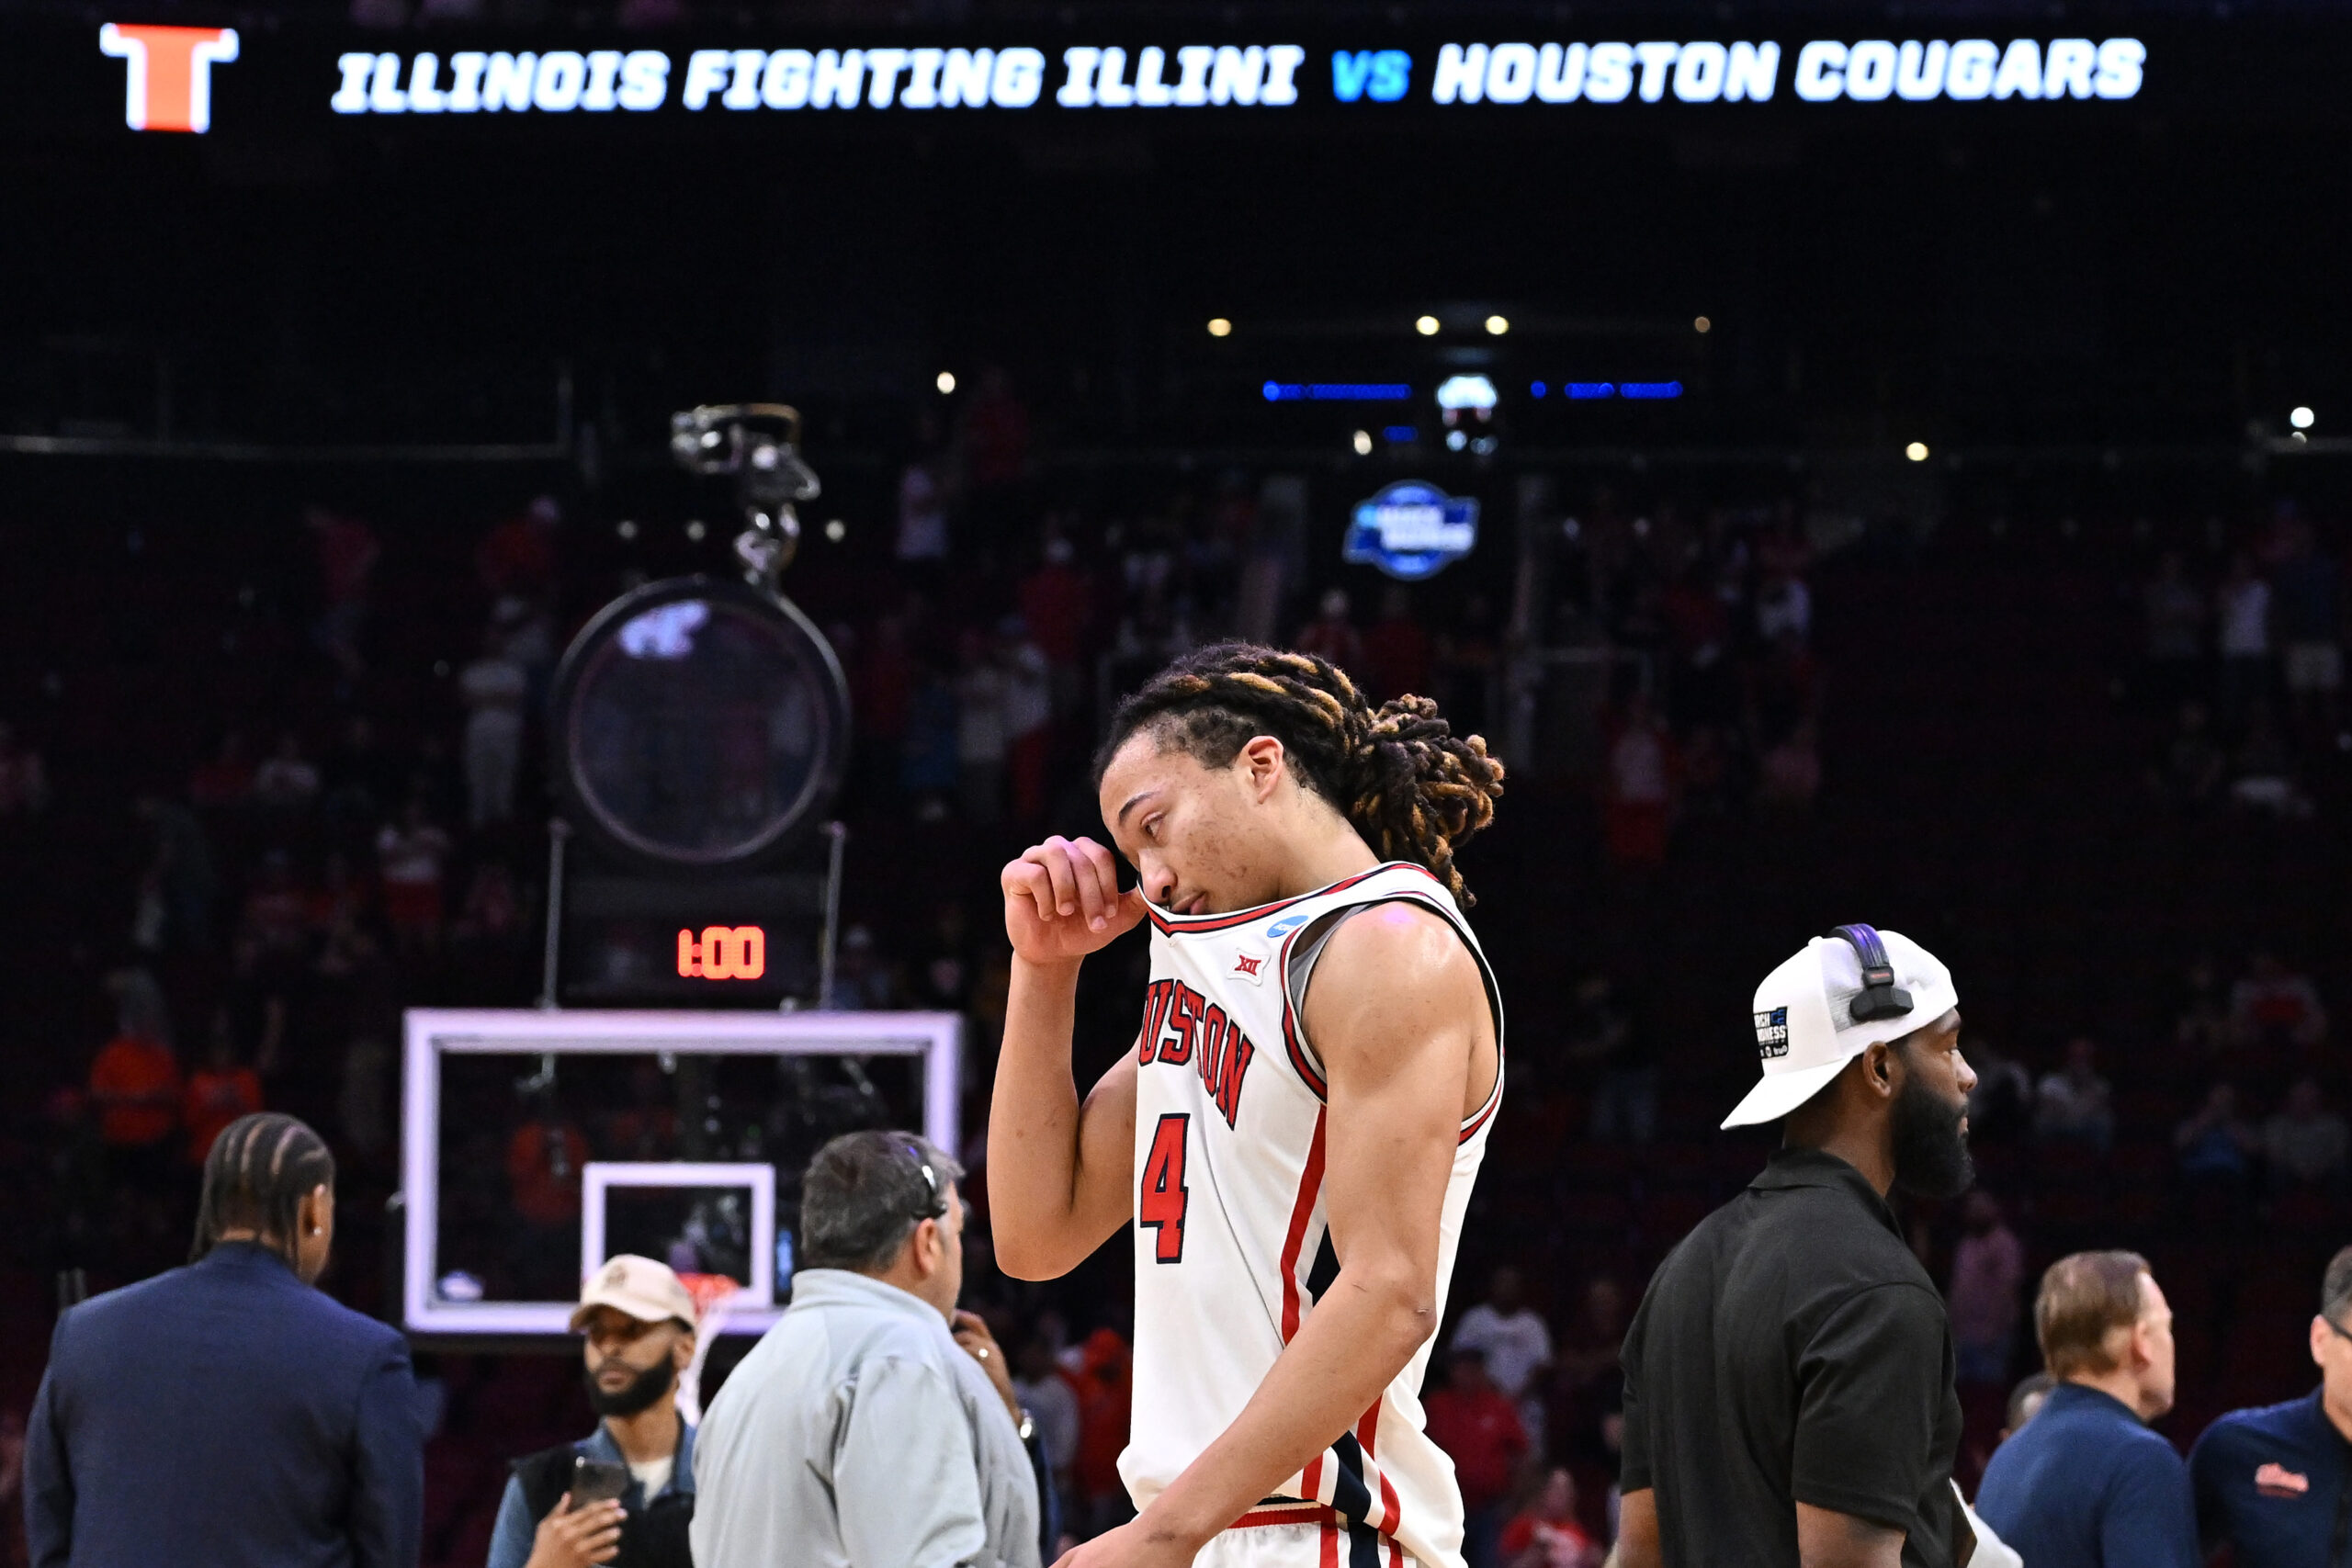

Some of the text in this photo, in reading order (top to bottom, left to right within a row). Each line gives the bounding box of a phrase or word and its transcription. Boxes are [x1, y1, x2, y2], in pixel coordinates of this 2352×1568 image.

[331, 38, 2146, 114] ILLINOIS FIGHTING ILLINI VS HOUSTON COUGARS
[678, 926, 764, 979] 1:00
[1234, 954, 1262, 976] XII
[1754, 1012, 1770, 1028] RCH
[1140, 1113, 1191, 1264] 4
